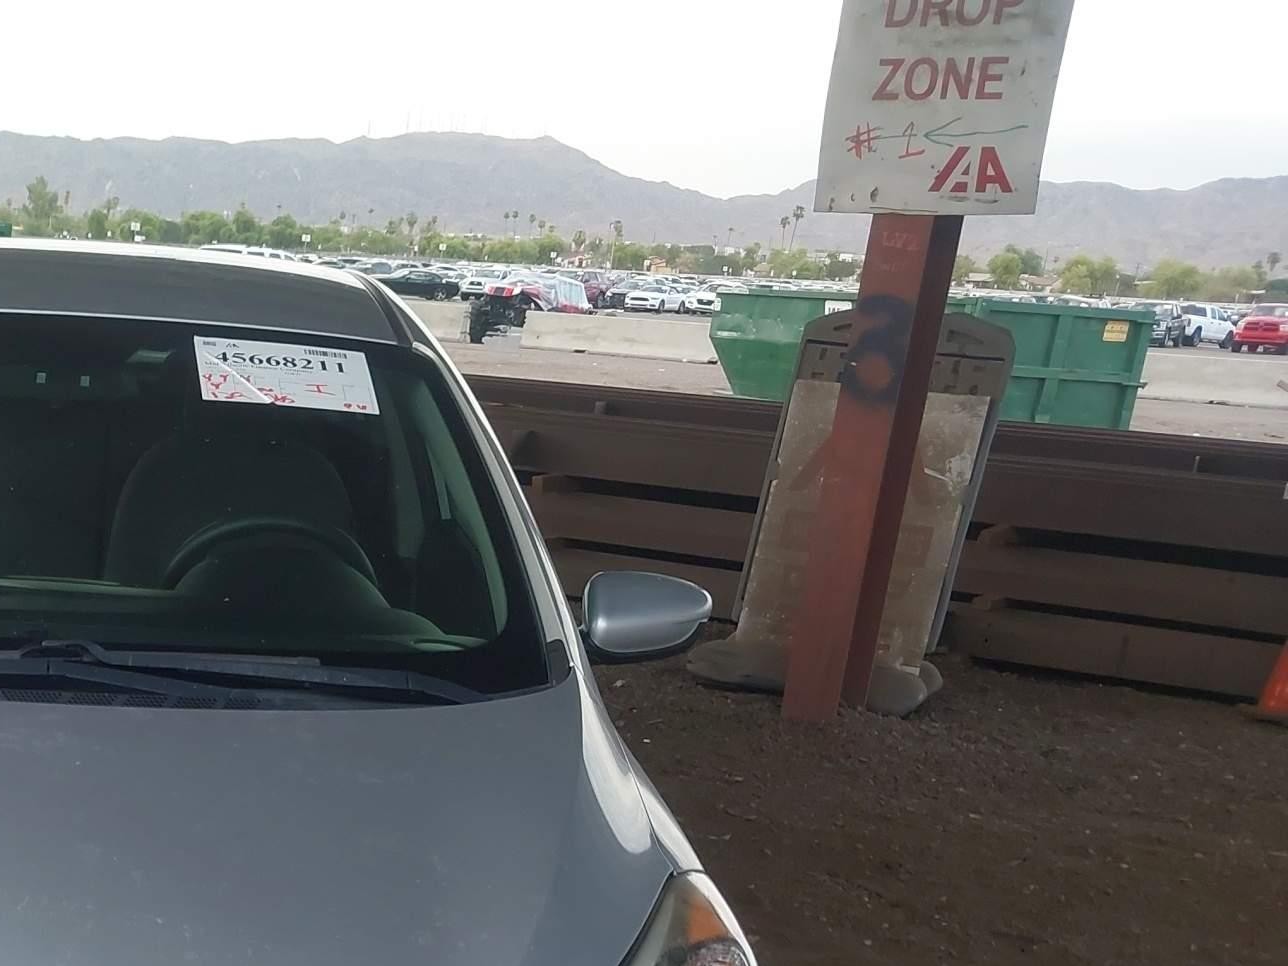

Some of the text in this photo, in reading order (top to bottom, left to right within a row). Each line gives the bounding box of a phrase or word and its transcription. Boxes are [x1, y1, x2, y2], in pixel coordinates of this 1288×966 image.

[884, 0, 1025, 28] DROP
[872, 56, 1010, 101] ZONE
[214, 351, 346, 374] 45668211
